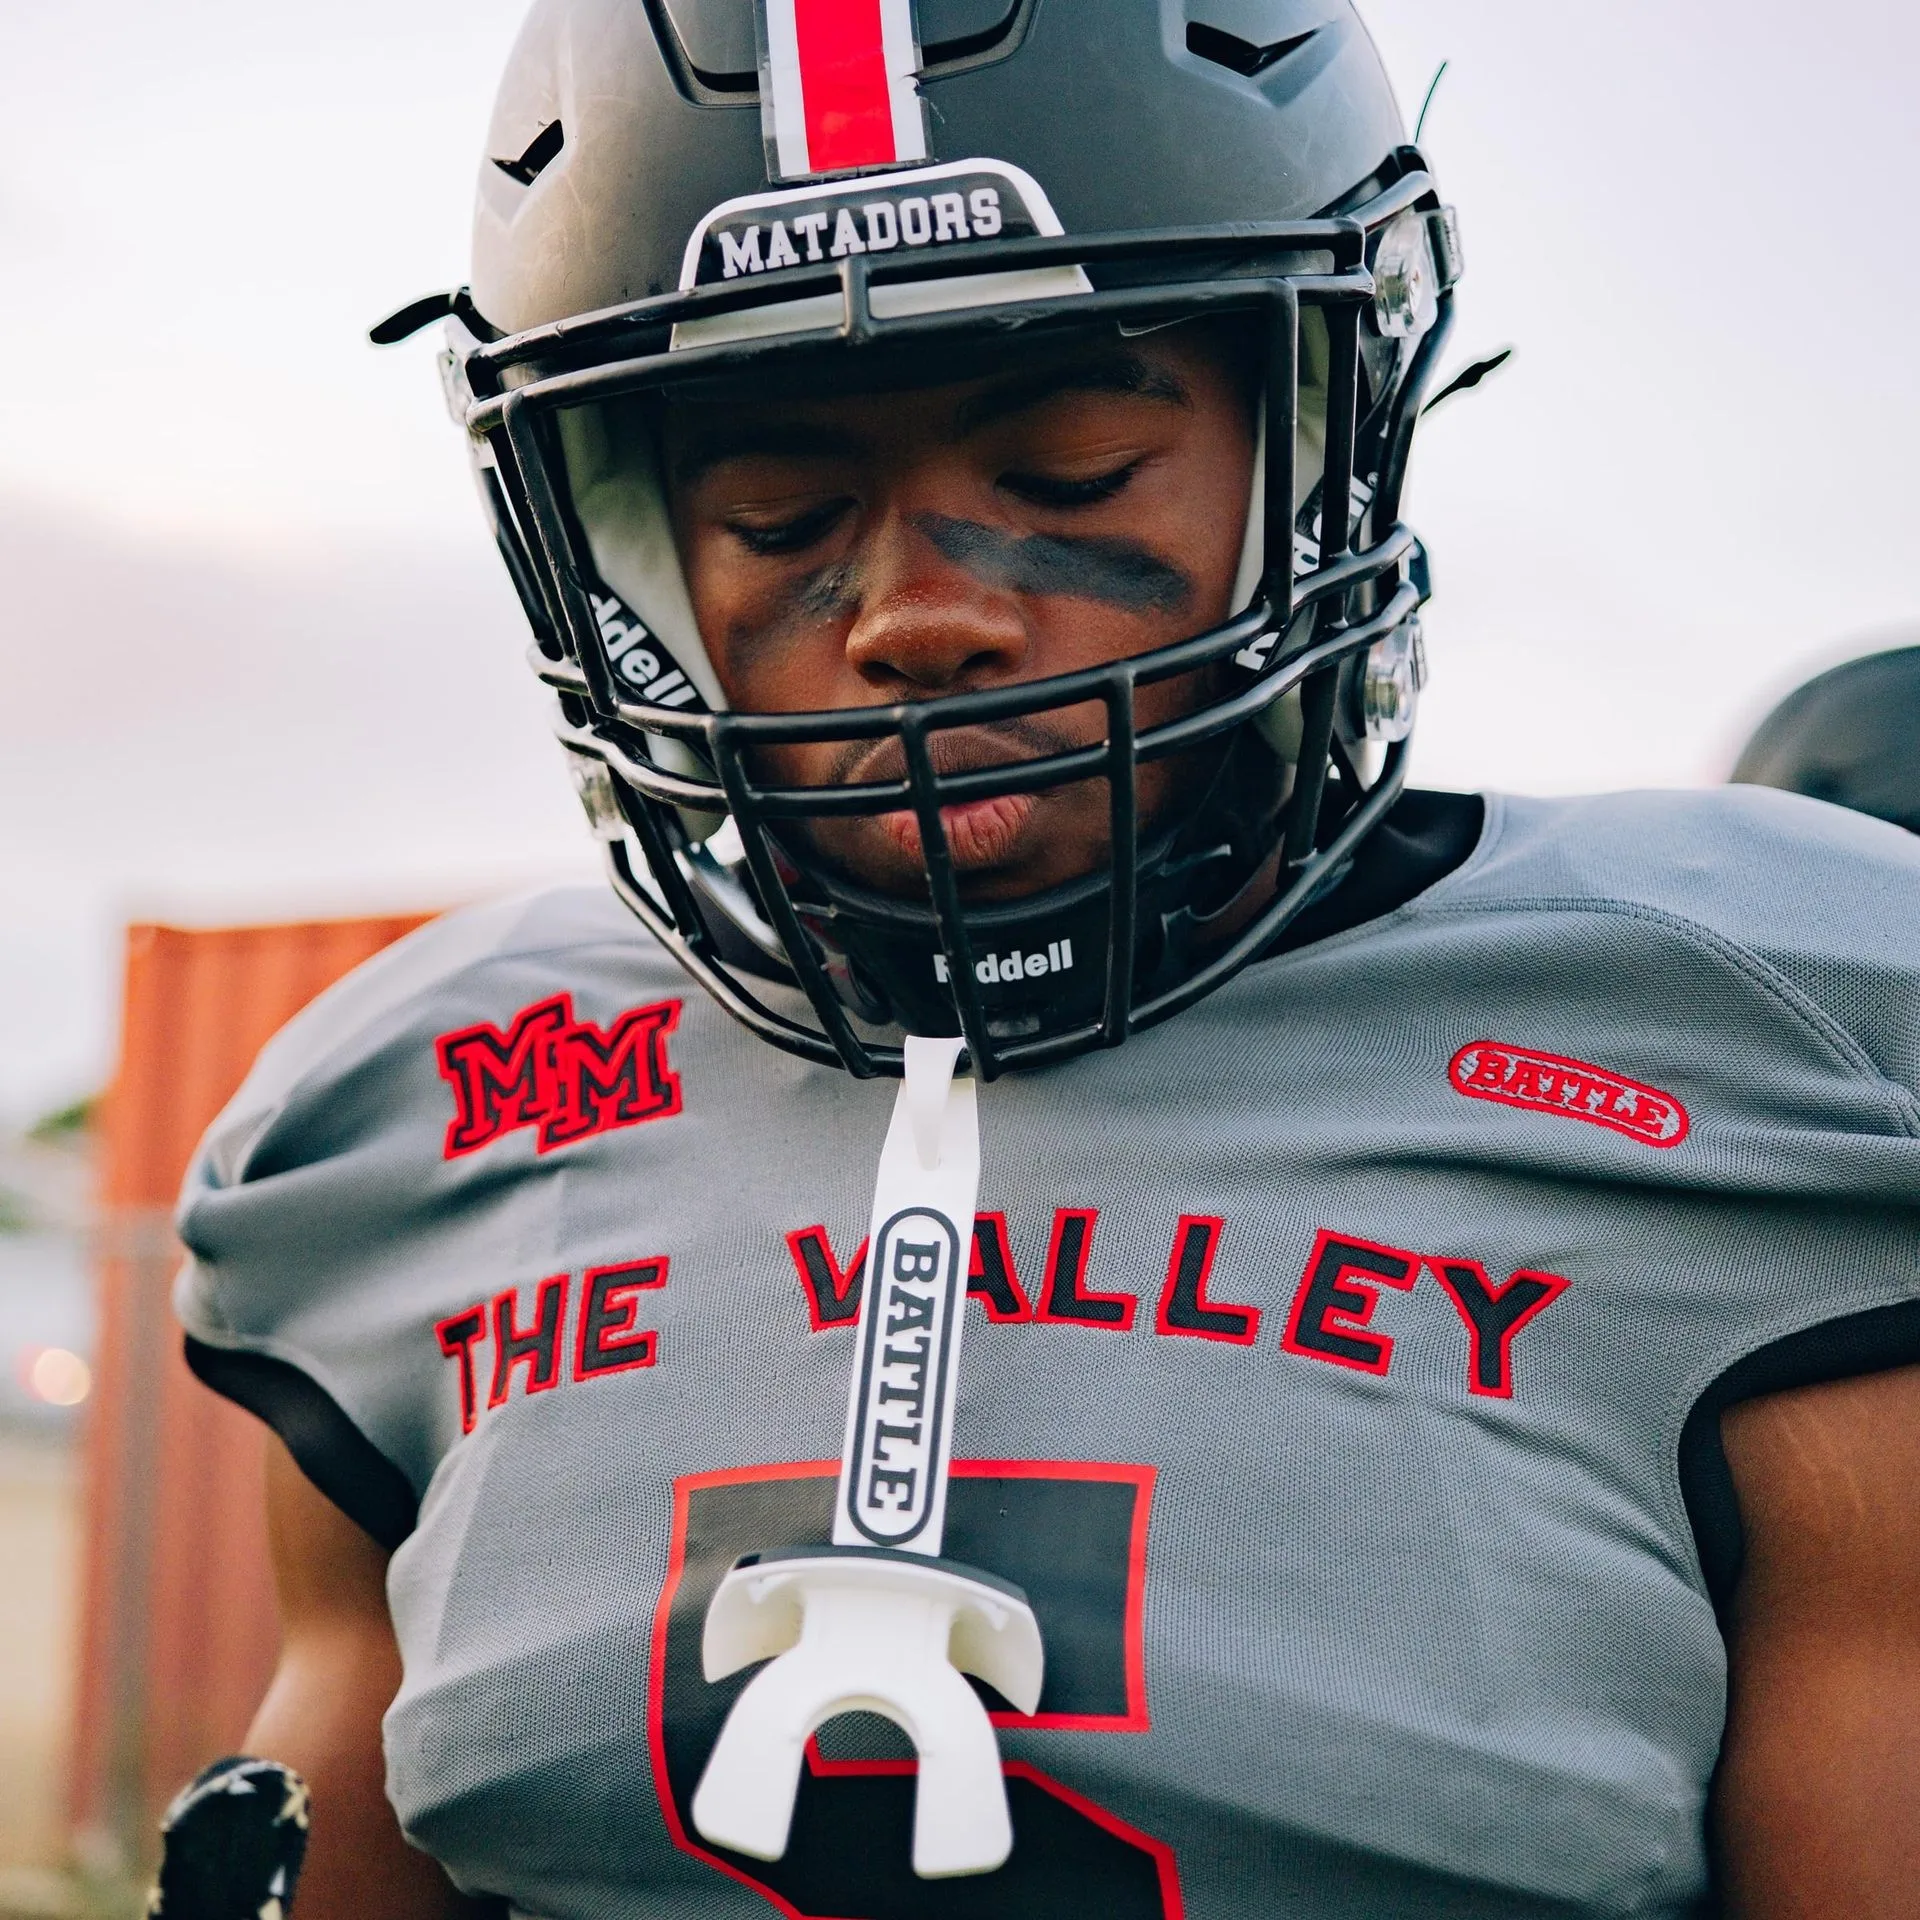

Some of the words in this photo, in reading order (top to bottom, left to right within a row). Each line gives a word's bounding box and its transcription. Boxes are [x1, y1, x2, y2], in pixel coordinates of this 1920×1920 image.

[718, 187, 1002, 279] MATADORS
[933, 938, 1073, 984] Rddell
[434, 991, 683, 1161] MM
[1466, 1050, 1670, 1137] BATTLE
[434, 1255, 669, 1435] THE
[867, 1237, 941, 1513] BATTLE
